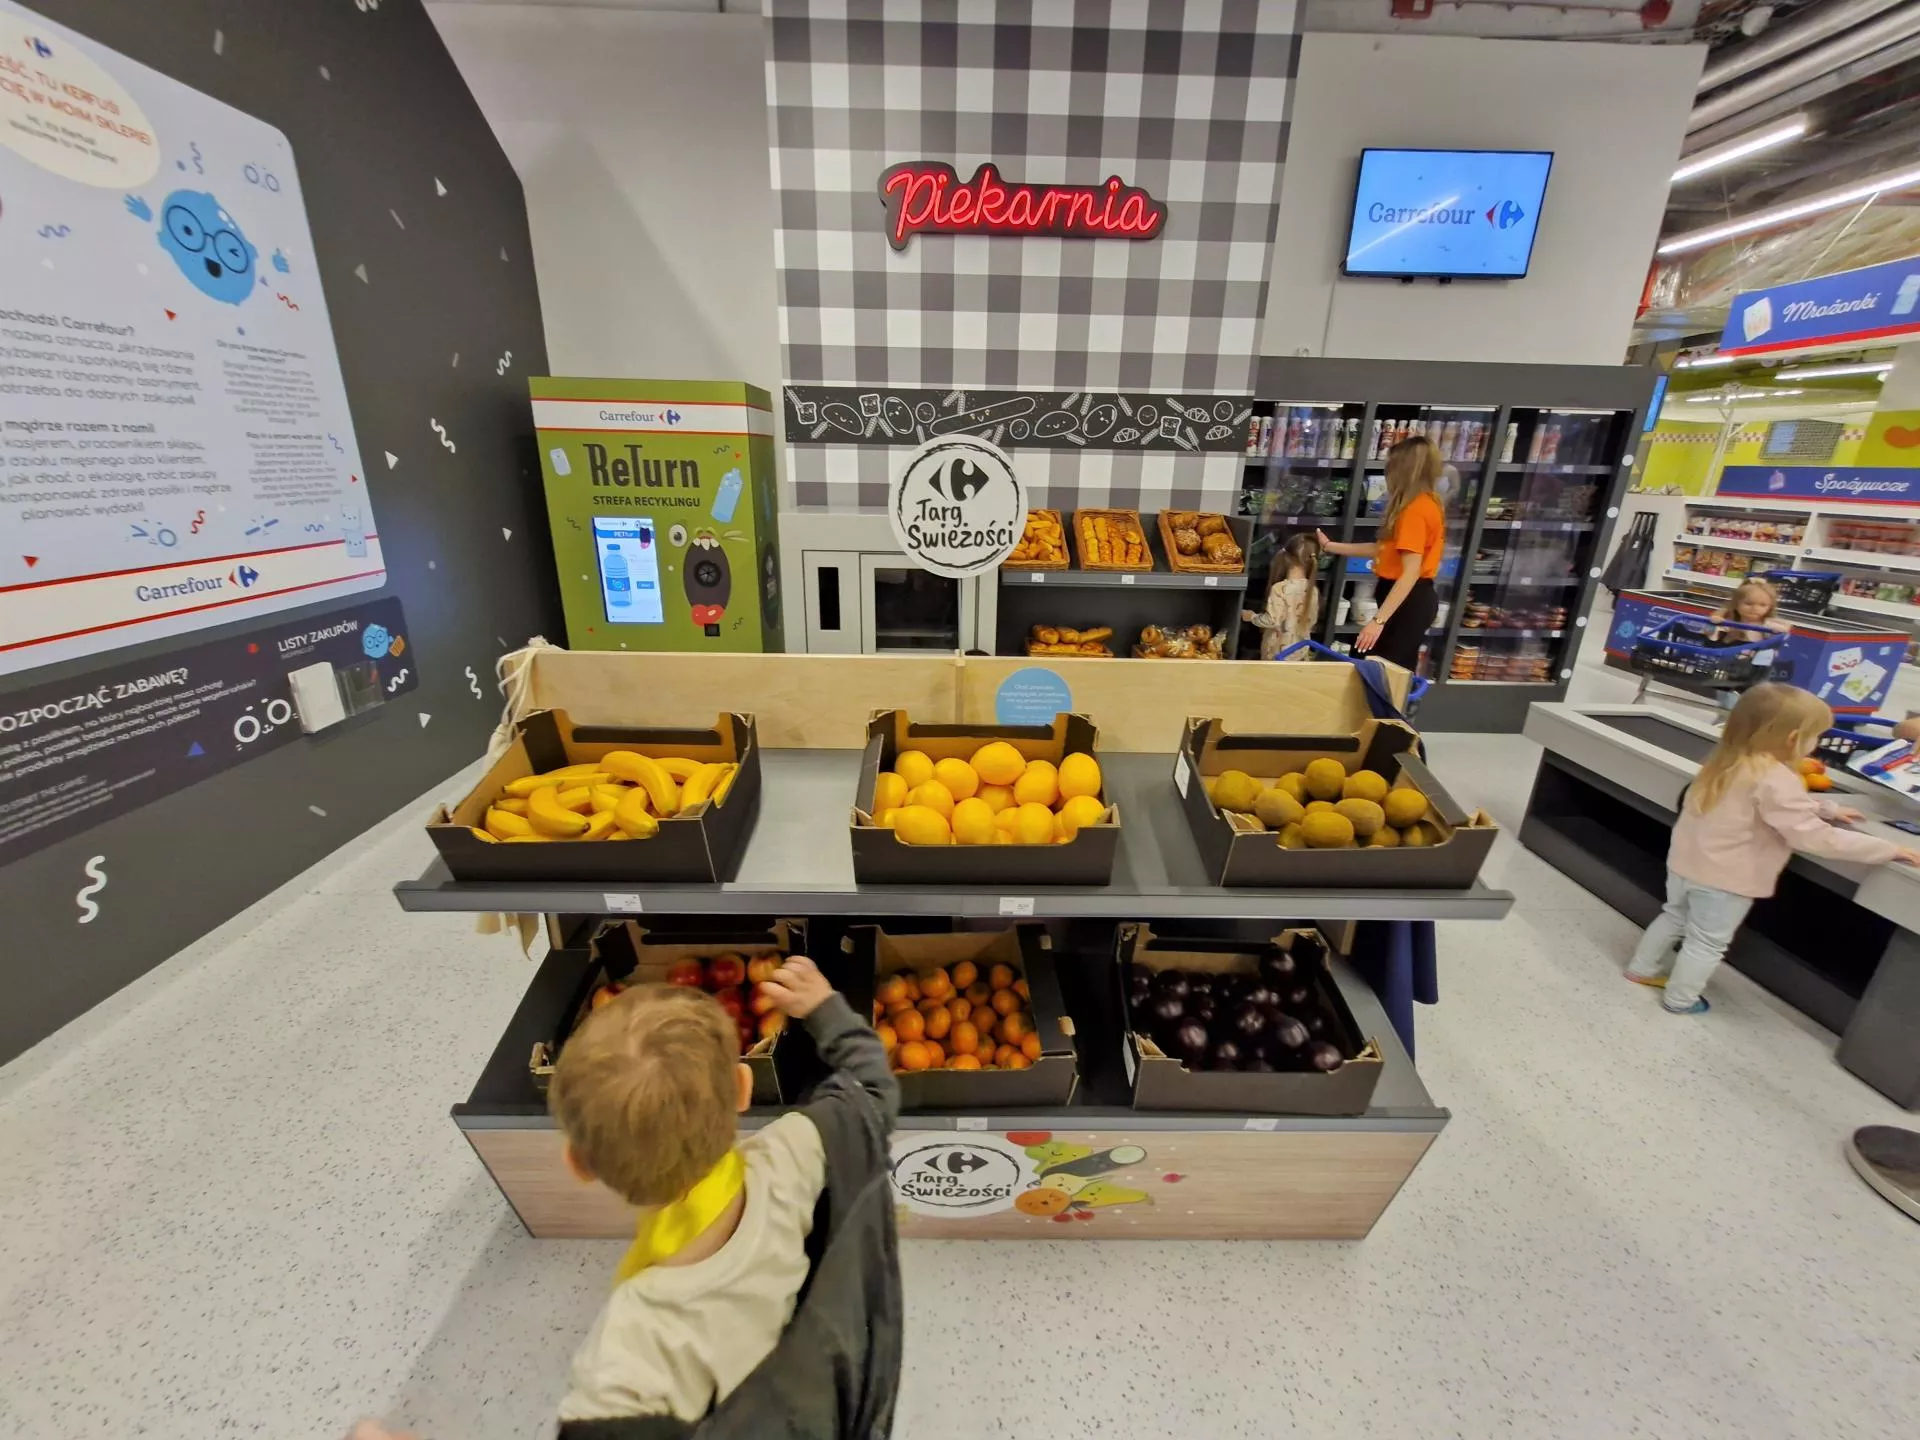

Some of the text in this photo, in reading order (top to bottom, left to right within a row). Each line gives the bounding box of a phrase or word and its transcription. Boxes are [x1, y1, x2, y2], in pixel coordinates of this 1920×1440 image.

[886, 169, 1157, 238] Piekarnia
[1368, 201, 1475, 225] Carrefour
[0, 309, 58, 327] ochodzi
[1782, 292, 1882, 323] Mrożonki
[0, 382, 61, 397] otrzeba
[5, 419, 63, 434] mądrze
[66, 423, 109, 432] razem
[112, 424, 118, 432] z
[599, 410, 655, 422] Carrefour
[100, 487, 145, 499] zdrowe
[1814, 472, 1910, 495] Spożywcze
[593, 495, 700, 507] STREFA RECYKLINGU
[21, 504, 91, 523] planować
[916, 498, 962, 528] Targ
[907, 515, 1014, 550] Świeżości
[136, 573, 223, 602] Carrefour
[278, 620, 358, 652] LISTY ZAKUPÓW
[0, 667, 188, 733] OZPOCZĄĆ ZABAWĘ?
[901, 1179, 1011, 1198] Świeżości
[911, 1171, 959, 1187] Targ
